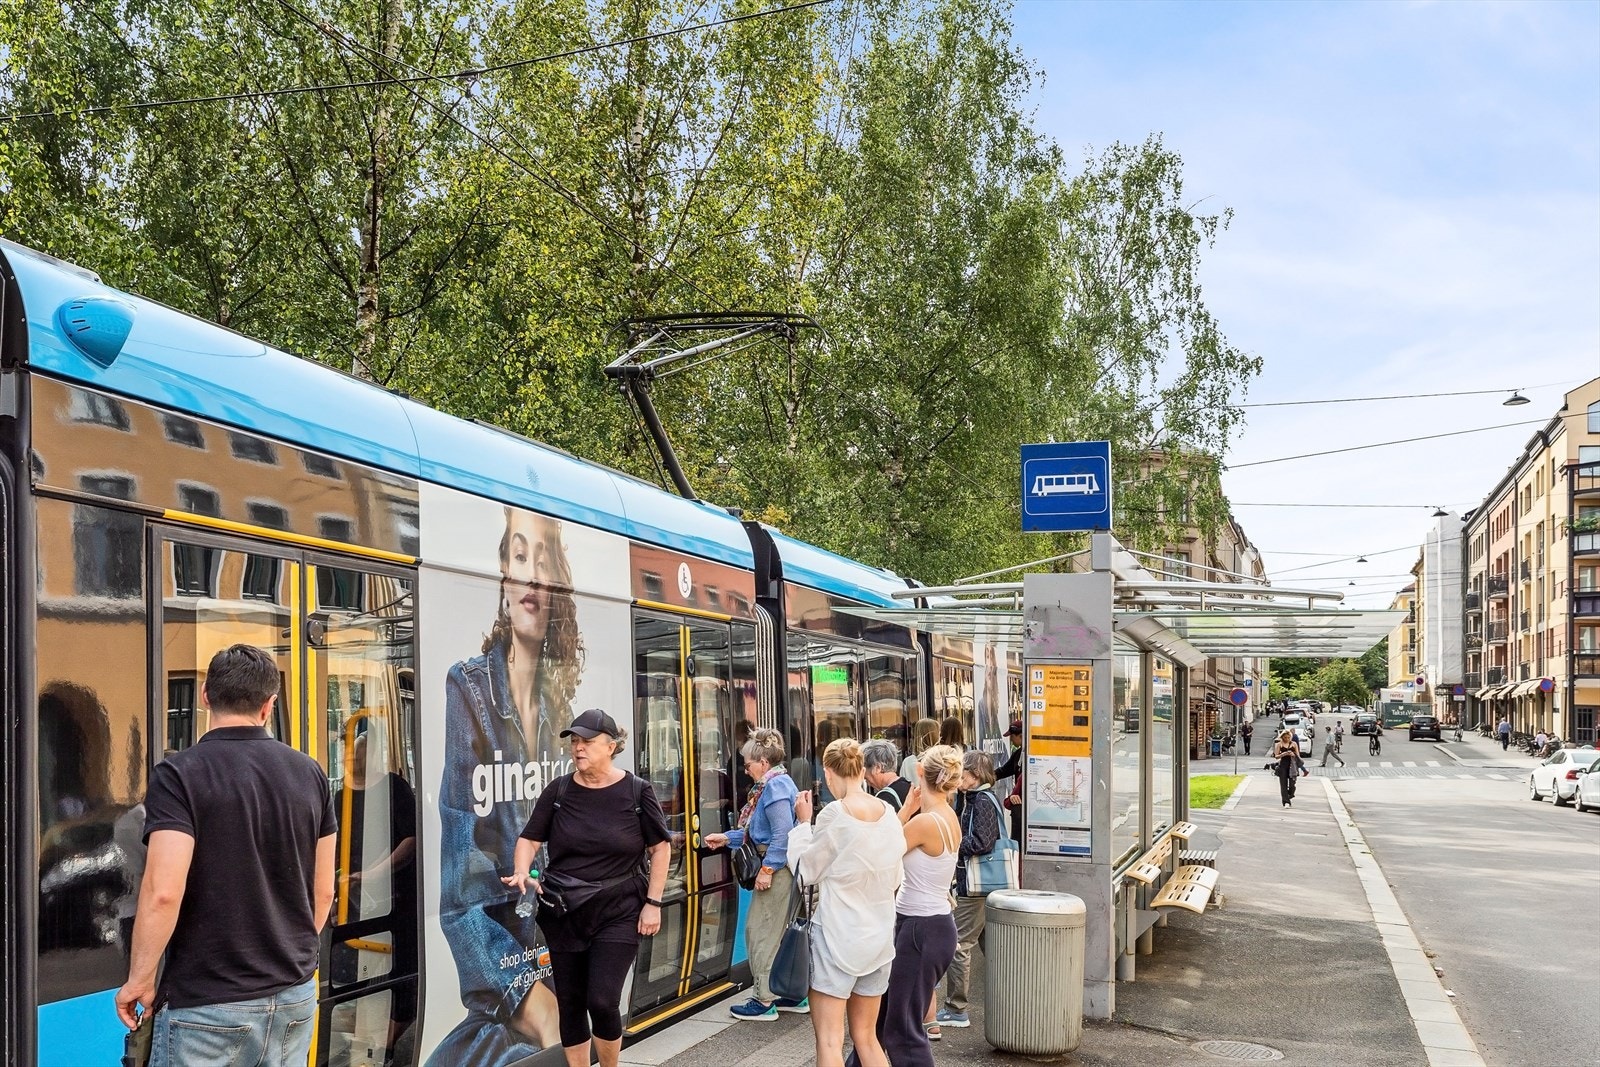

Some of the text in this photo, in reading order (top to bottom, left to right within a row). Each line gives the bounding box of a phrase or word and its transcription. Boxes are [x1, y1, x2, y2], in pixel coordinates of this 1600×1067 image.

[1035, 671, 1042, 679] 11
[1080, 671, 1087, 679] 7
[1034, 686, 1043, 694] 12
[1080, 686, 1087, 695] 5
[1033, 701, 1043, 709] 18
[1080, 702, 1086, 710] 1
[500, 953, 520, 969] shop
[514, 974, 522, 988] at
